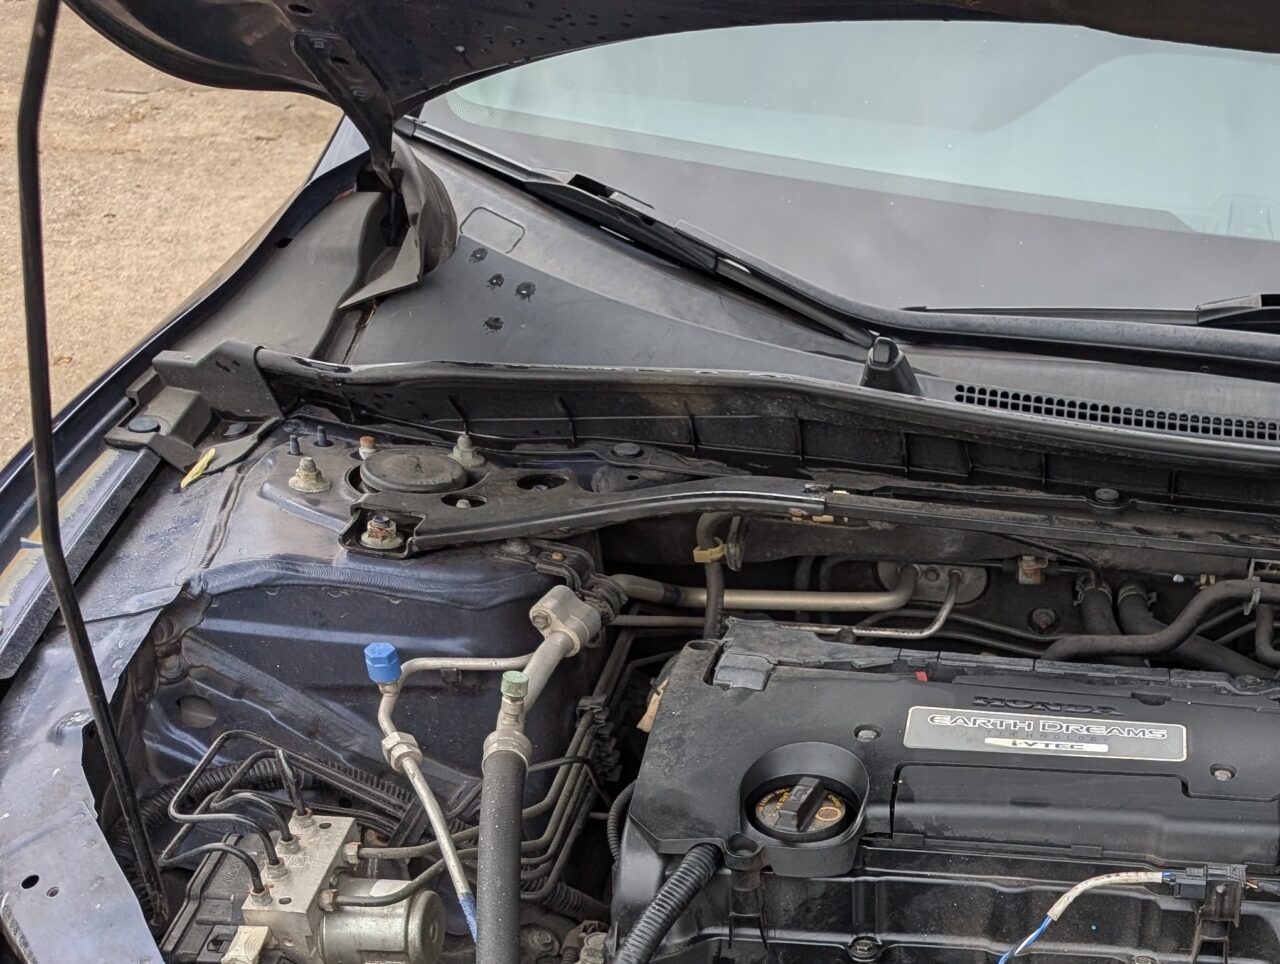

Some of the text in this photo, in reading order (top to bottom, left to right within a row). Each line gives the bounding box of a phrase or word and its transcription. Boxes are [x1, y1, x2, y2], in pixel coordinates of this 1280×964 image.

[972, 695, 1125, 716] HONDA
[927, 714, 1168, 740] EARTH DREAMS
[986, 730, 1111, 744] TECHNOLOGY
[1010, 739, 1085, 750] i-VTEC
